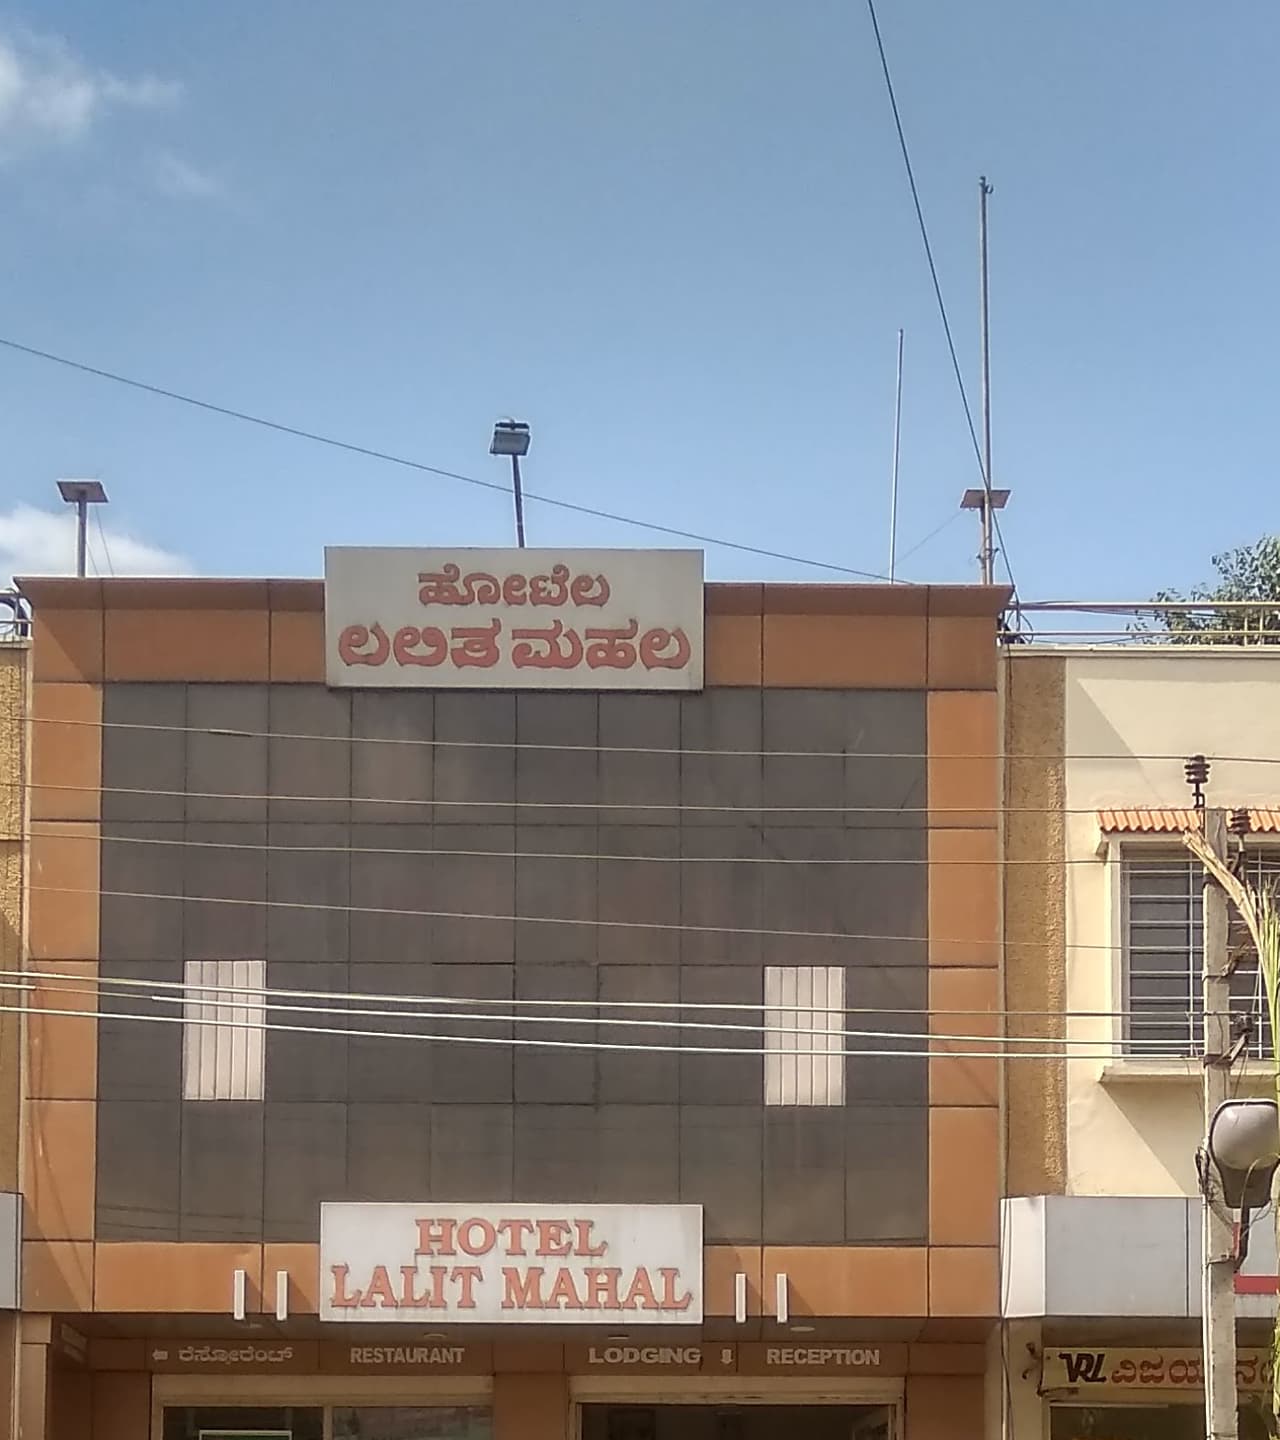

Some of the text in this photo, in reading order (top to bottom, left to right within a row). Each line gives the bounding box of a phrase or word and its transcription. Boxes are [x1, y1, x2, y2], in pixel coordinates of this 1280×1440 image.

[338, 618, 692, 671] ಲಲಿತ ಮಹಲ
[414, 1216, 607, 1257] HOTEL
[330, 1266, 693, 1312] LALIT MAHAL
[349, 1346, 466, 1365] RESTAURANT
[588, 1346, 702, 1366] LODGING
[766, 1347, 881, 1367] RECEPTION
[1058, 1352, 1108, 1384] VRL
